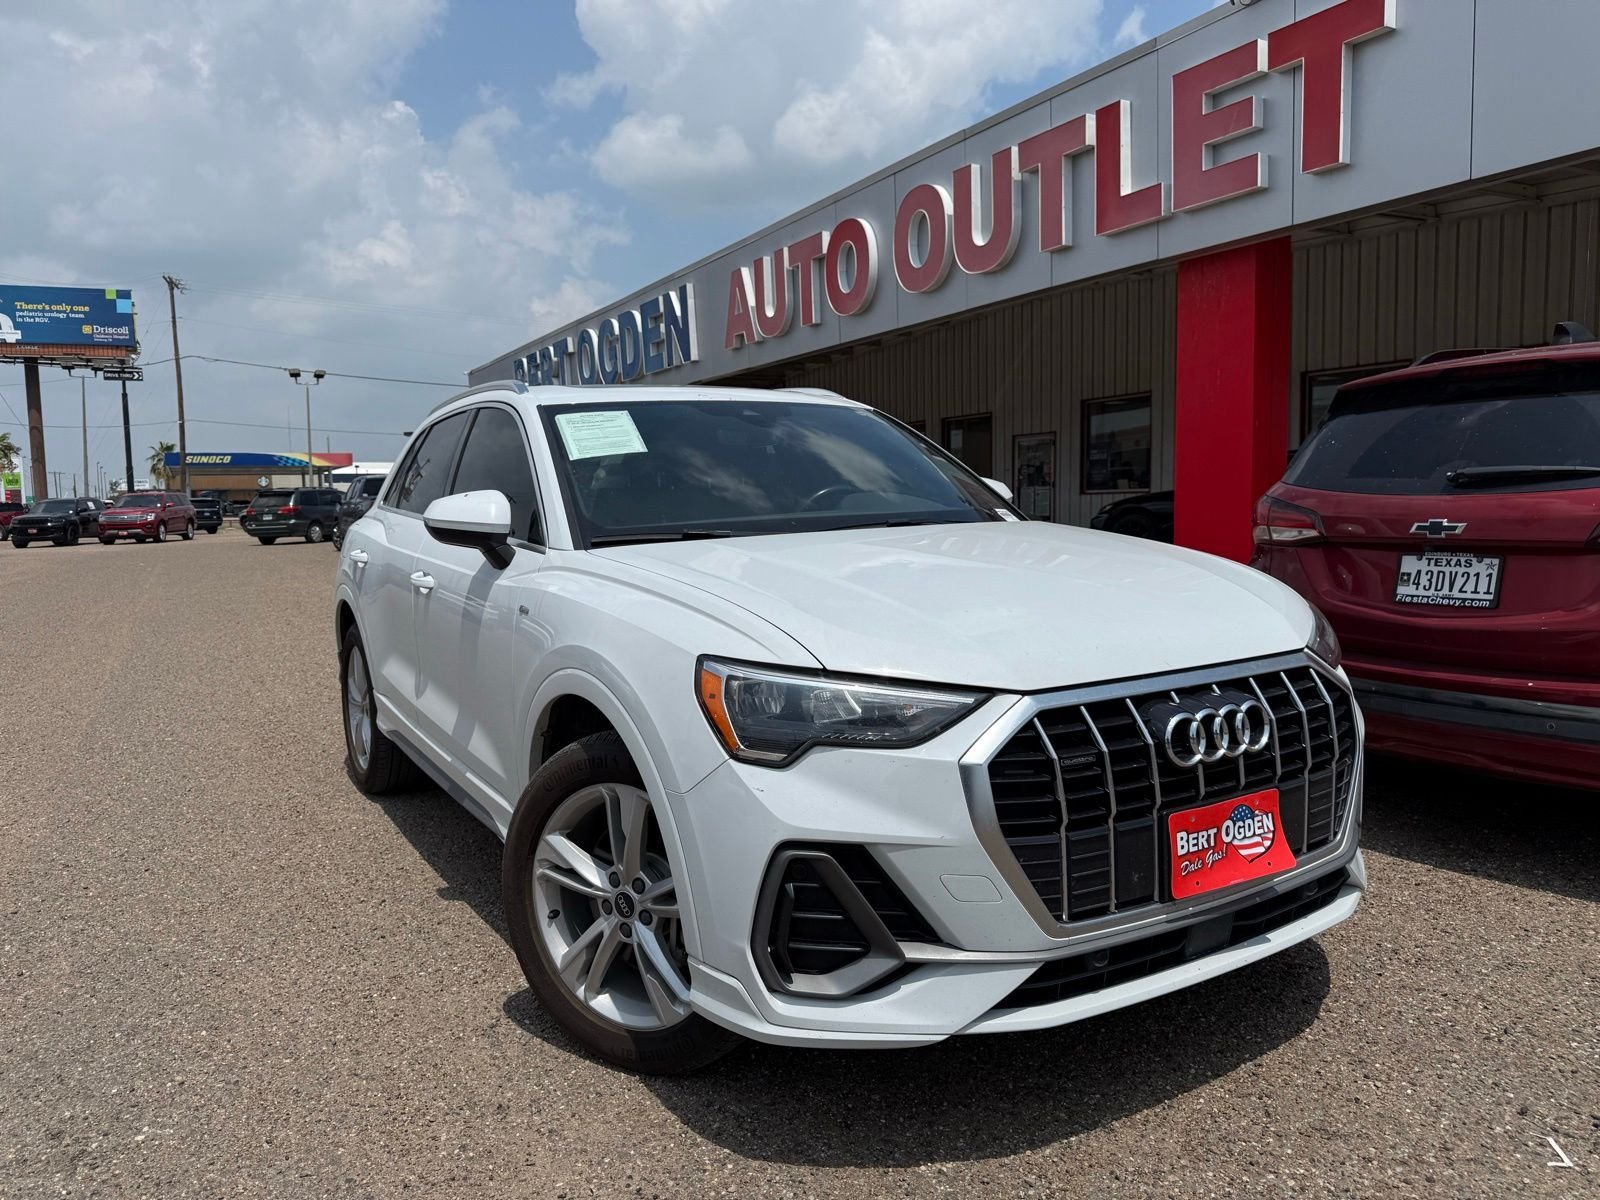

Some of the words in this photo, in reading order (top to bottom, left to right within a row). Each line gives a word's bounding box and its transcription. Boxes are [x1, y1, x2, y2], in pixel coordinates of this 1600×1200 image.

[514, 336, 575, 386] BERT
[577, 283, 699, 385] OGDEN
[724, 218, 878, 349] AUTO
[893, 0, 1396, 295] OUTLET
[15, 302, 50, 310] There's
[51, 303, 71, 312] only
[93, 325, 129, 334] Driscoll
[185, 455, 232, 464] SUNOCO
[1425, 557, 1473, 569] TEXAS
[1411, 569, 1494, 596] 43DV211
[1396, 594, 1490, 607] FiestaChevy.com
[1176, 827, 1218, 857] BERT
[1221, 813, 1275, 844] OGDEN
[1180, 857, 1203, 876] Dale
[1205, 843, 1227, 869] Gas!
